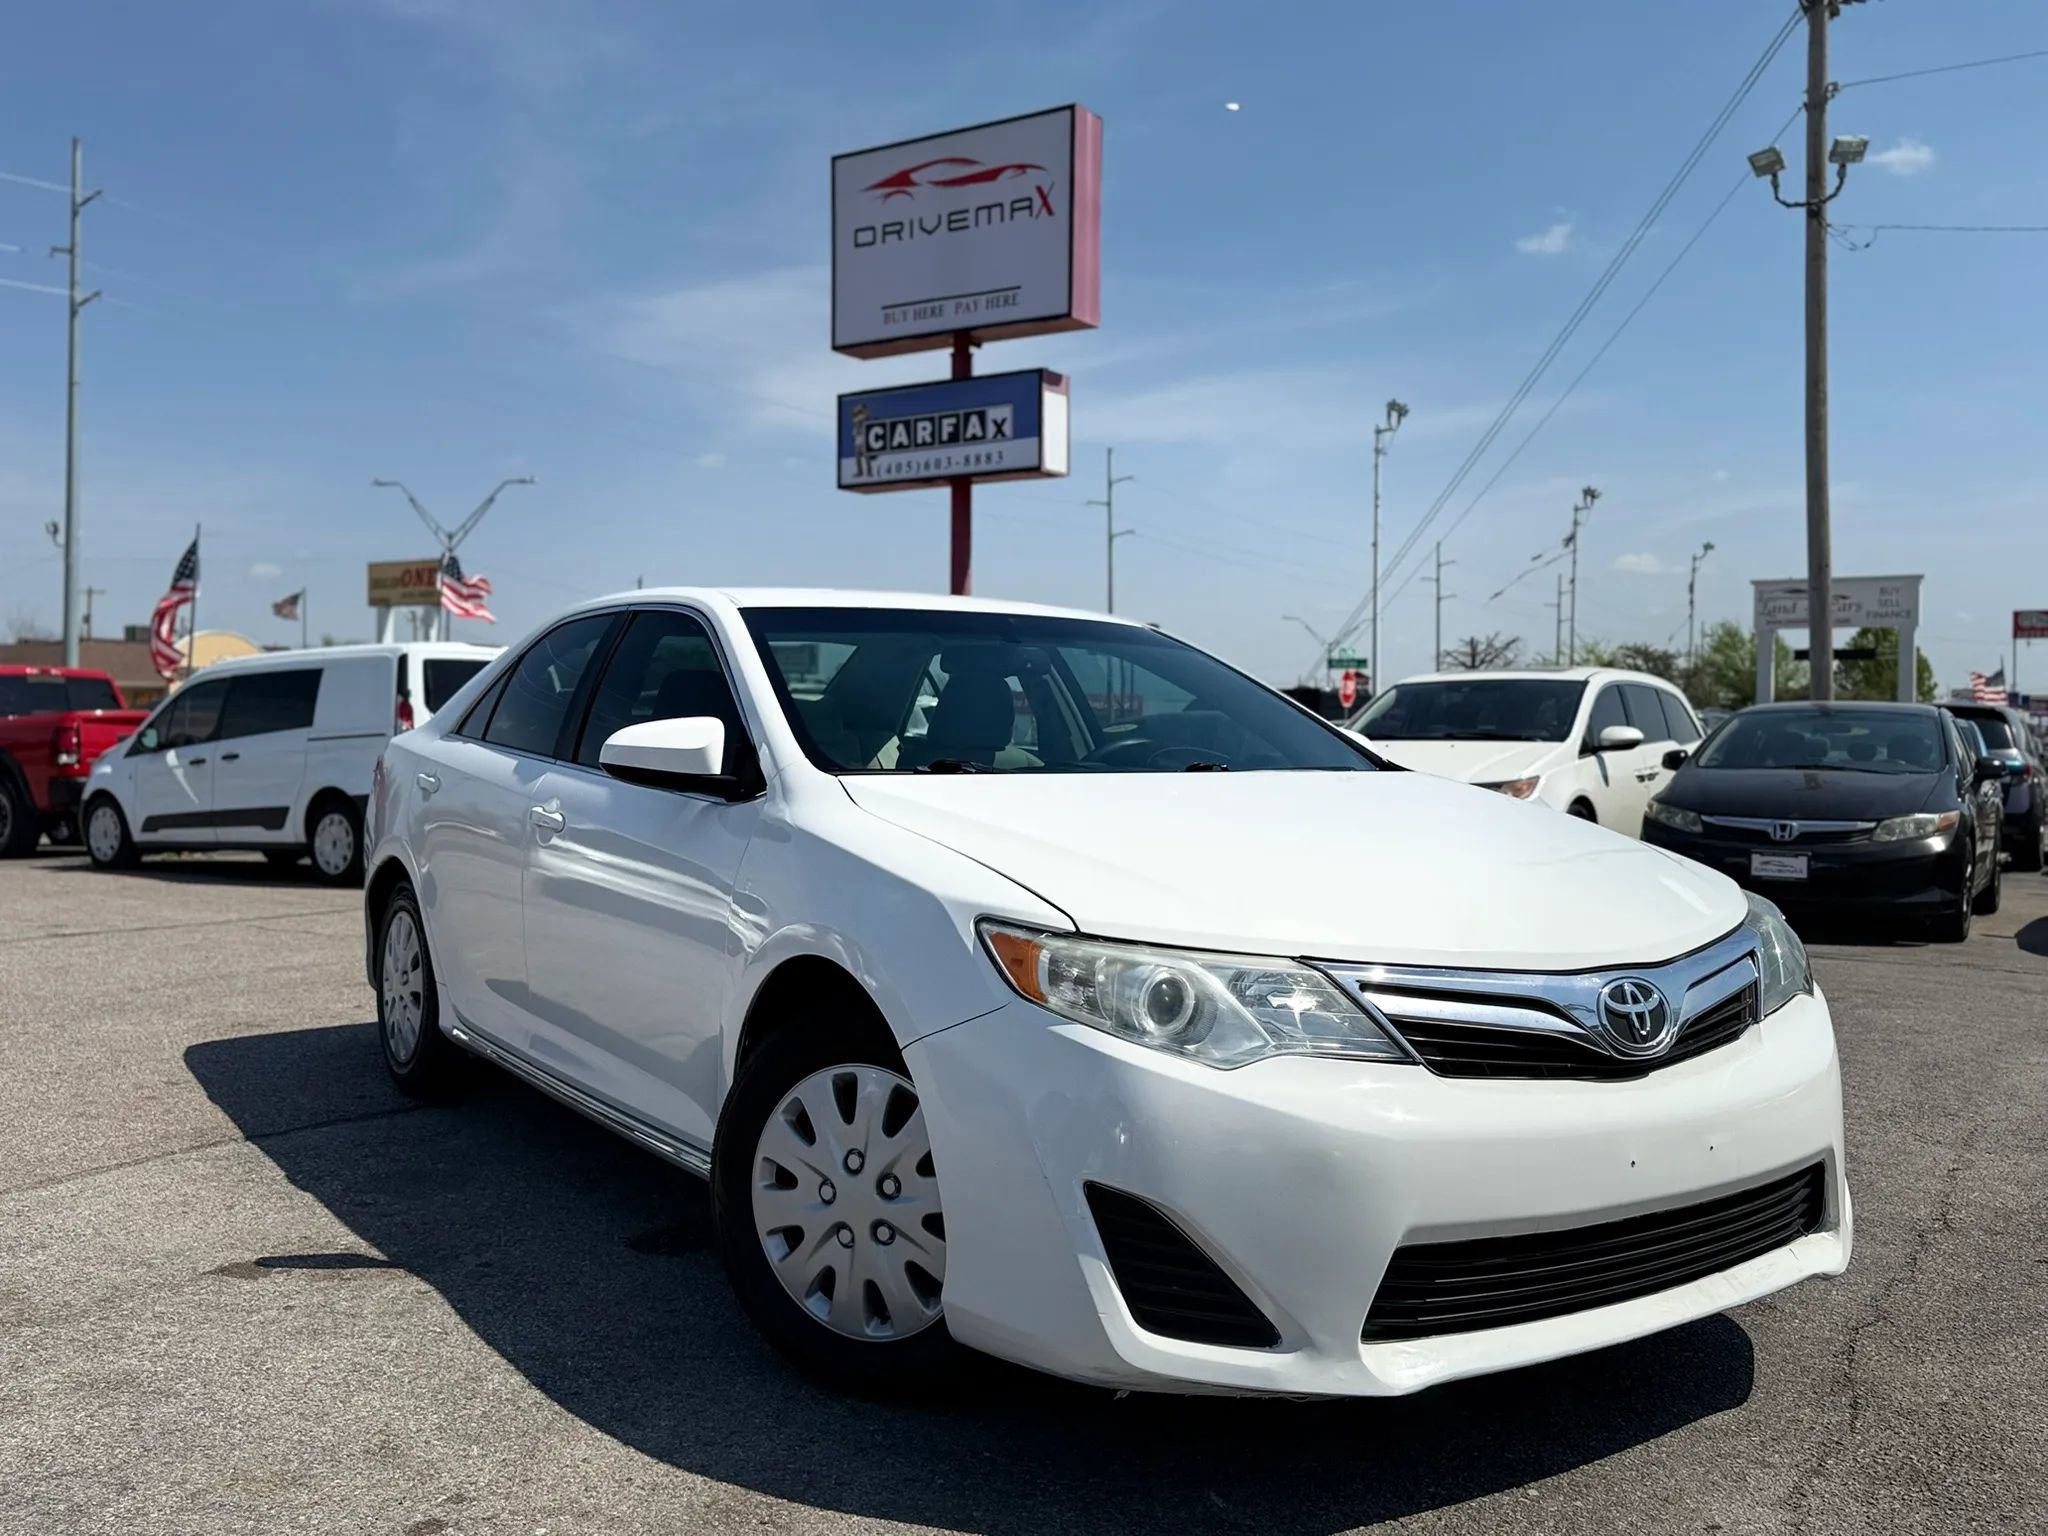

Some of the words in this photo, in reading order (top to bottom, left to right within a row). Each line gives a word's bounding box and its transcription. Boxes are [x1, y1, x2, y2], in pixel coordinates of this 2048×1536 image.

[853, 183, 1055, 249] DRIVEMAX
[883, 310, 910, 325] BUY
[913, 305, 945, 321] HERE
[954, 300, 981, 316] PAY
[985, 293, 1020, 310] HERE
[867, 413, 1009, 450] CARFAX
[1879, 586, 1900, 595] BUY
[1866, 610, 1912, 619] FINANCE
